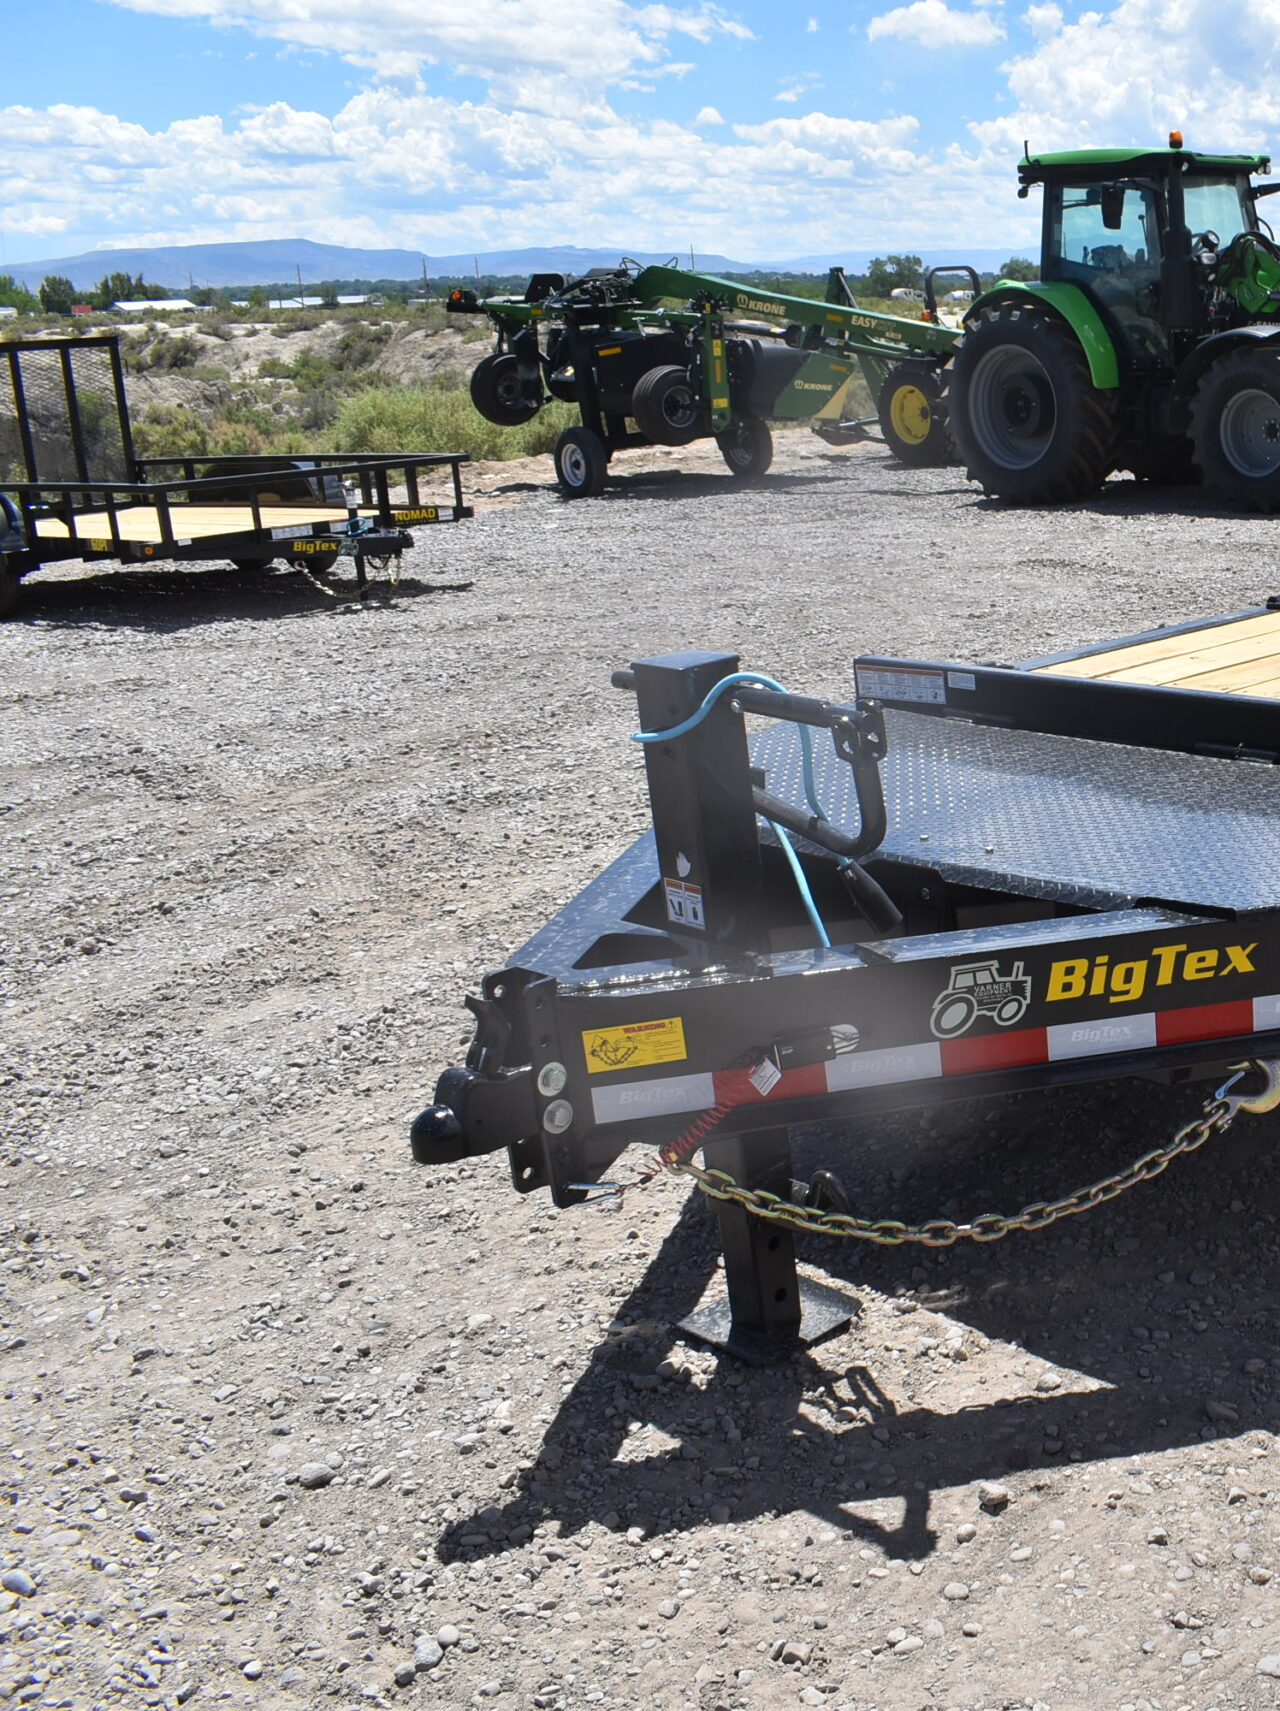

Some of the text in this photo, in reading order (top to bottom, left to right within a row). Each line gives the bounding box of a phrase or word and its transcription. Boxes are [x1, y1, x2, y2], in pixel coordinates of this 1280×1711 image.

[749, 300, 786, 316] KRONE
[803, 382, 833, 392] KRONE
[394, 508, 436, 522] NOMAD
[293, 540, 337, 554] BigTex
[1045, 942, 1259, 1004] BigTex
[974, 981, 1012, 992] VARNER
[1071, 1024, 1133, 1043] BigTex
[851, 1055, 915, 1073] BigTex
[619, 1087, 687, 1105] BigTex
